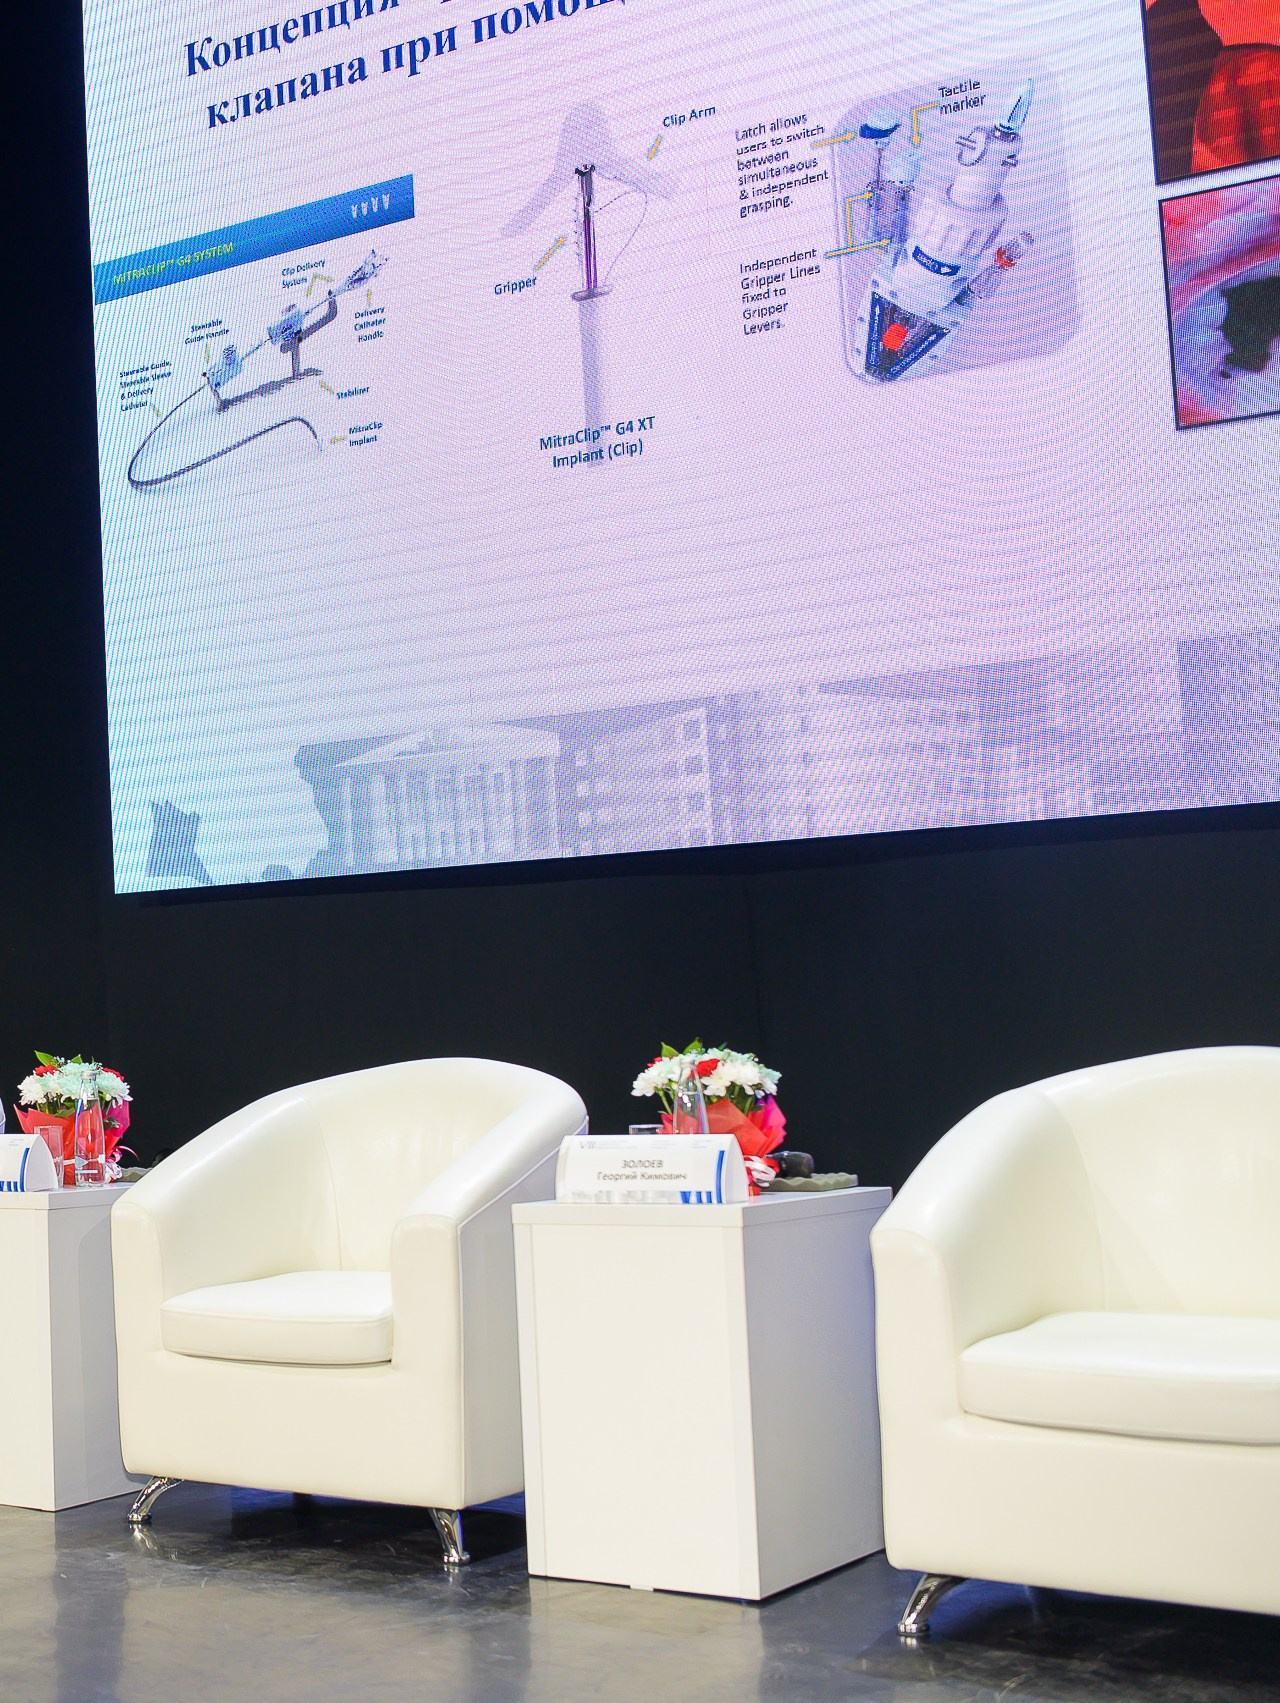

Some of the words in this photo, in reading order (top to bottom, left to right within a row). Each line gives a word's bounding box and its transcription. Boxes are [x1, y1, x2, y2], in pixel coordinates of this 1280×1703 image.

[206, 53, 368, 128] клапана
[380, 26, 458, 77] при
[938, 79, 981, 98] Tactile
[940, 94, 987, 115] marker
[662, 113, 686, 127] Clip
[689, 106, 716, 121] Arm
[735, 122, 766, 142] Latch
[769, 114, 808, 132] allows
[736, 141, 767, 155] users
[770, 137, 783, 146] to
[786, 124, 825, 143] switch
[737, 149, 789, 171] between
[738, 157, 818, 185] simultaneous
[739, 189, 749, 200] &
[752, 169, 829, 197] independent
[740, 195, 793, 218] grasping.
[193, 242, 234, 263] SYSTEM
[740, 248, 817, 274] Independent
[494, 276, 537, 295] Gripper
[741, 272, 786, 290] Gripper
[789, 264, 821, 280] Lines
[742, 288, 770, 304] fixed
[773, 287, 787, 297] to
[742, 302, 789, 320] Gripper
[615, 420, 634, 435] G4
[638, 415, 656, 432] XT
[349, 434, 378, 447] Implant
[552, 448, 604, 468] Implant
[608, 438, 643, 461] (Clip)
[621, 1159, 664, 1169] ЗОЛОЕВ
[597, 1170, 638, 1182] Георгий
